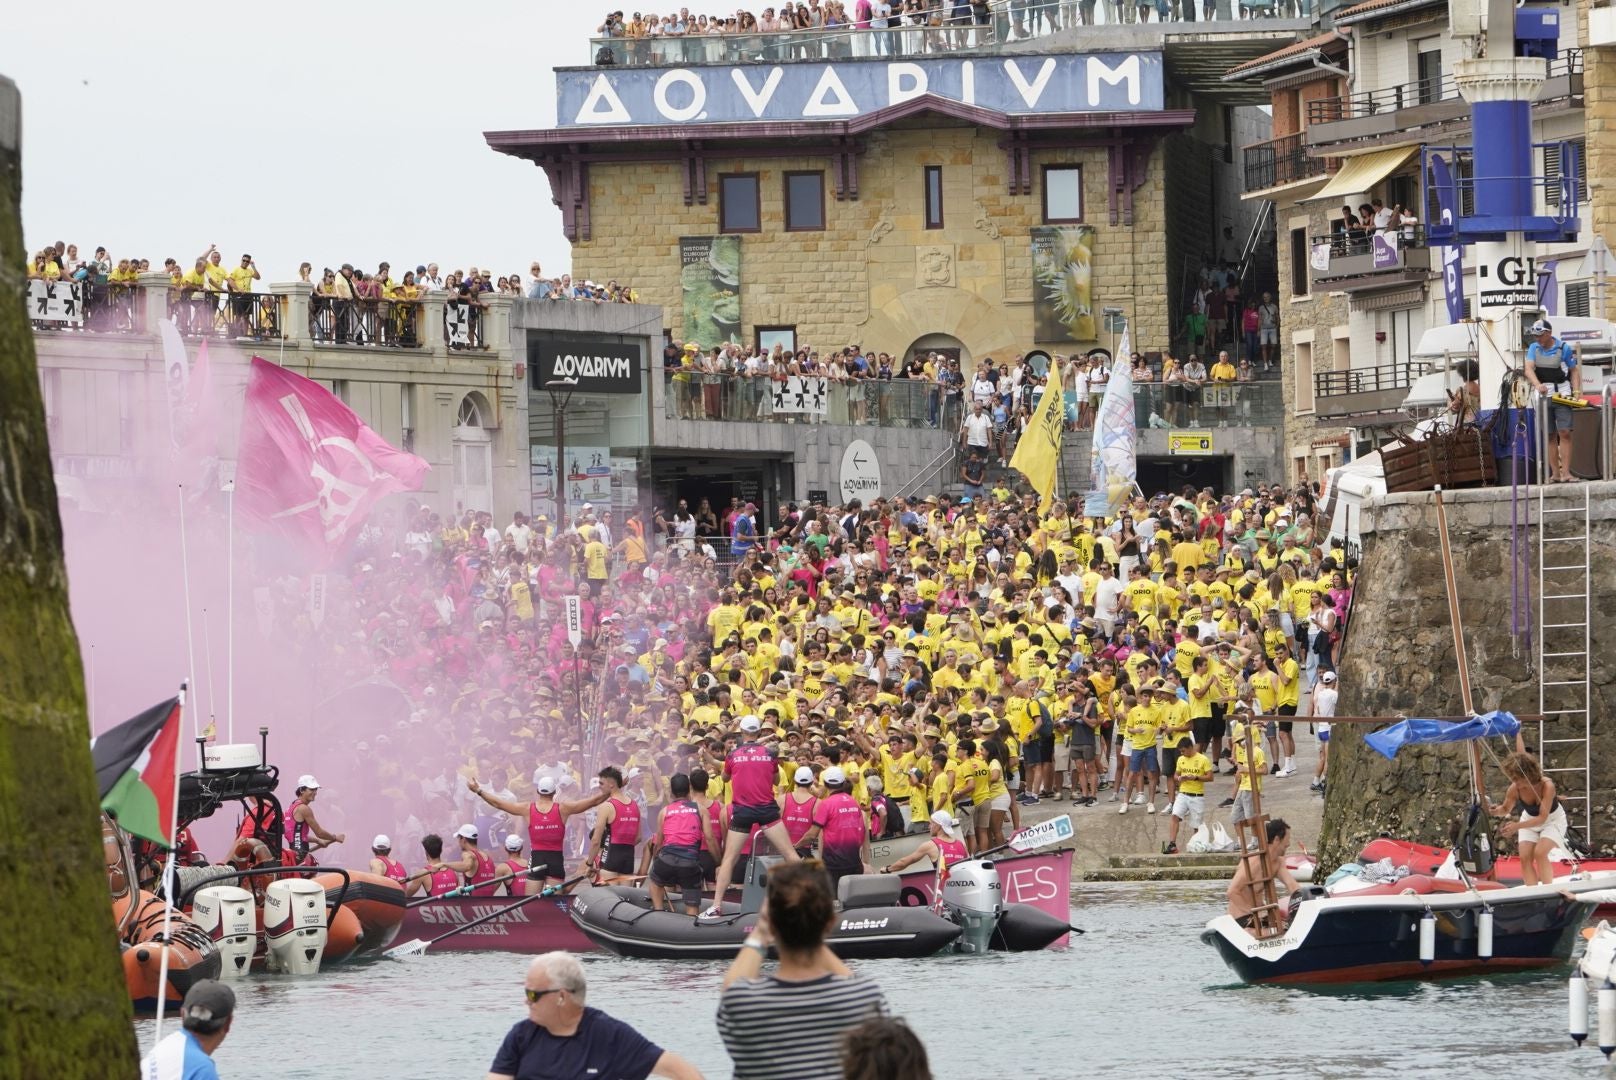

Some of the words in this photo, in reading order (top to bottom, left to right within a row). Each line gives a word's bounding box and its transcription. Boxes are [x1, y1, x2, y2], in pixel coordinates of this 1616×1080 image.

[1020, 822, 1055, 840] MOYUA
[419, 905, 468, 924] SAN
[472, 905, 530, 923] JUAN
[840, 918, 889, 930] Bombard
